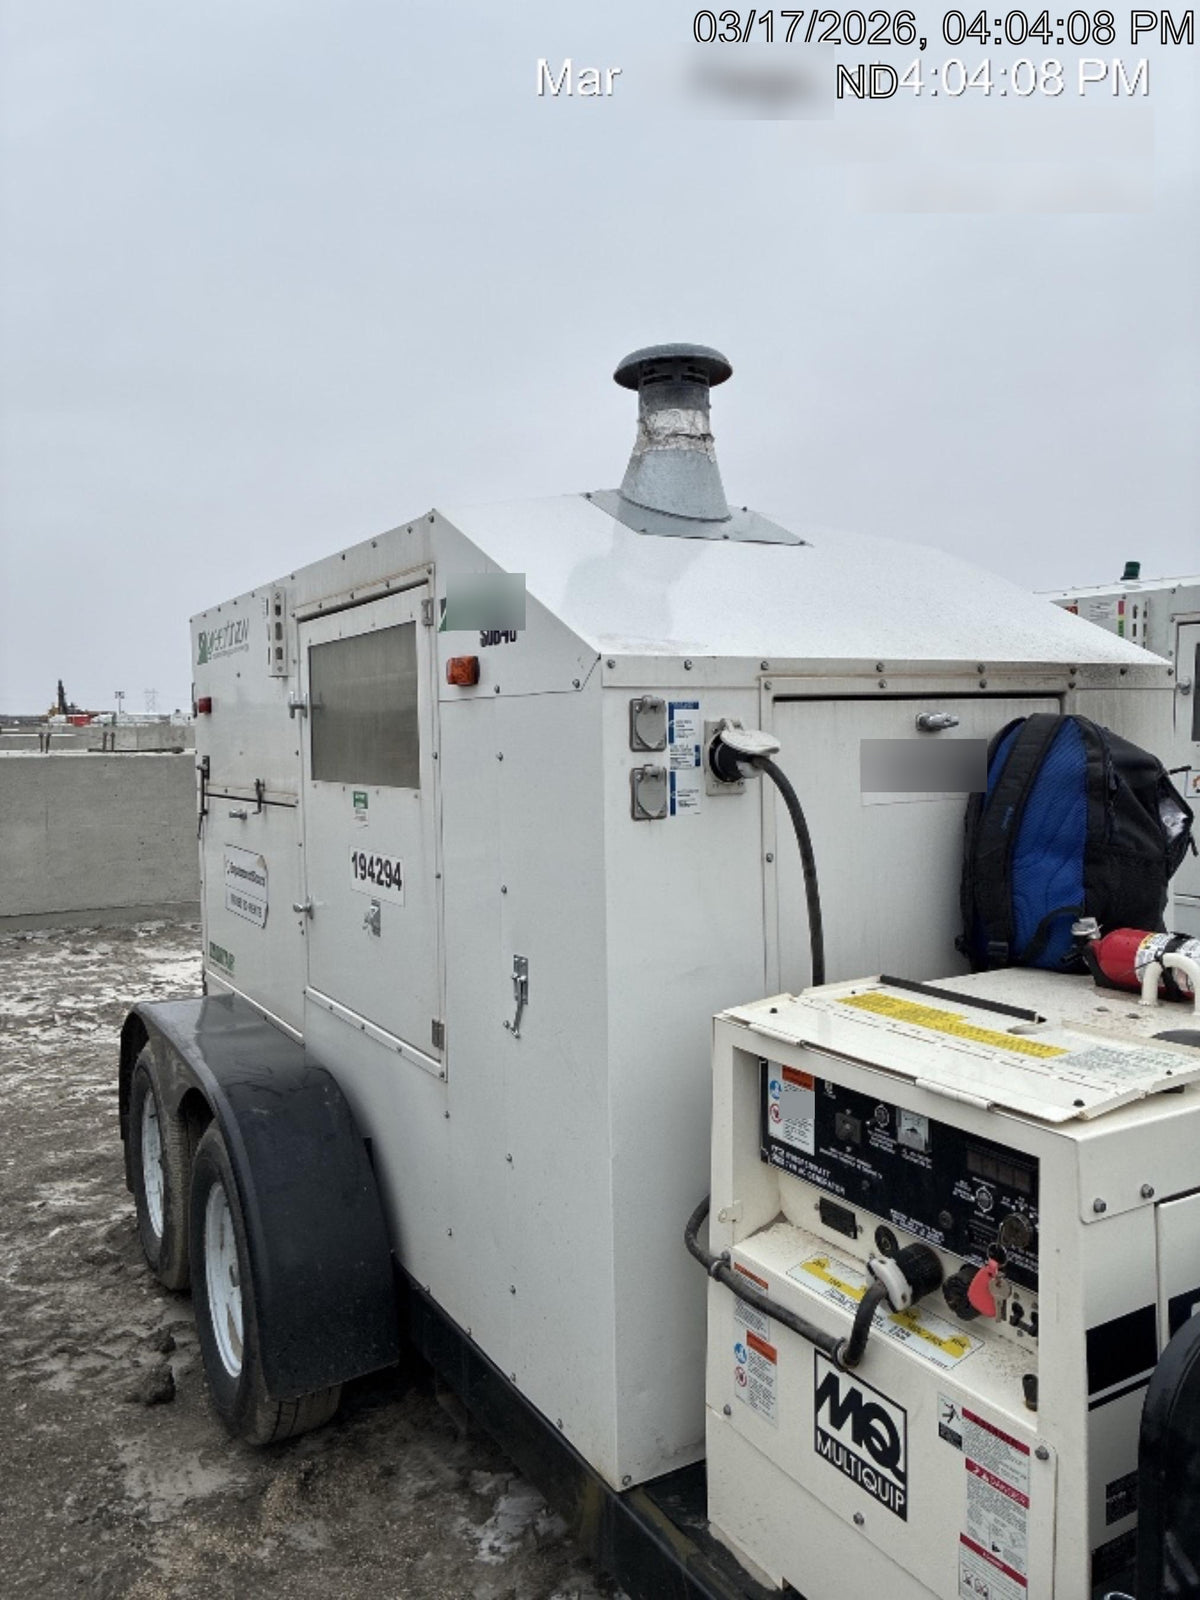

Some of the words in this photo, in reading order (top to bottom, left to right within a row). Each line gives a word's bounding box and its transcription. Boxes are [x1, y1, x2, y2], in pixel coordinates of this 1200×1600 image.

[351, 851, 403, 892] 194294
[815, 1370, 906, 1486] MQ
[816, 1430, 906, 1513] MULTIQUIP
